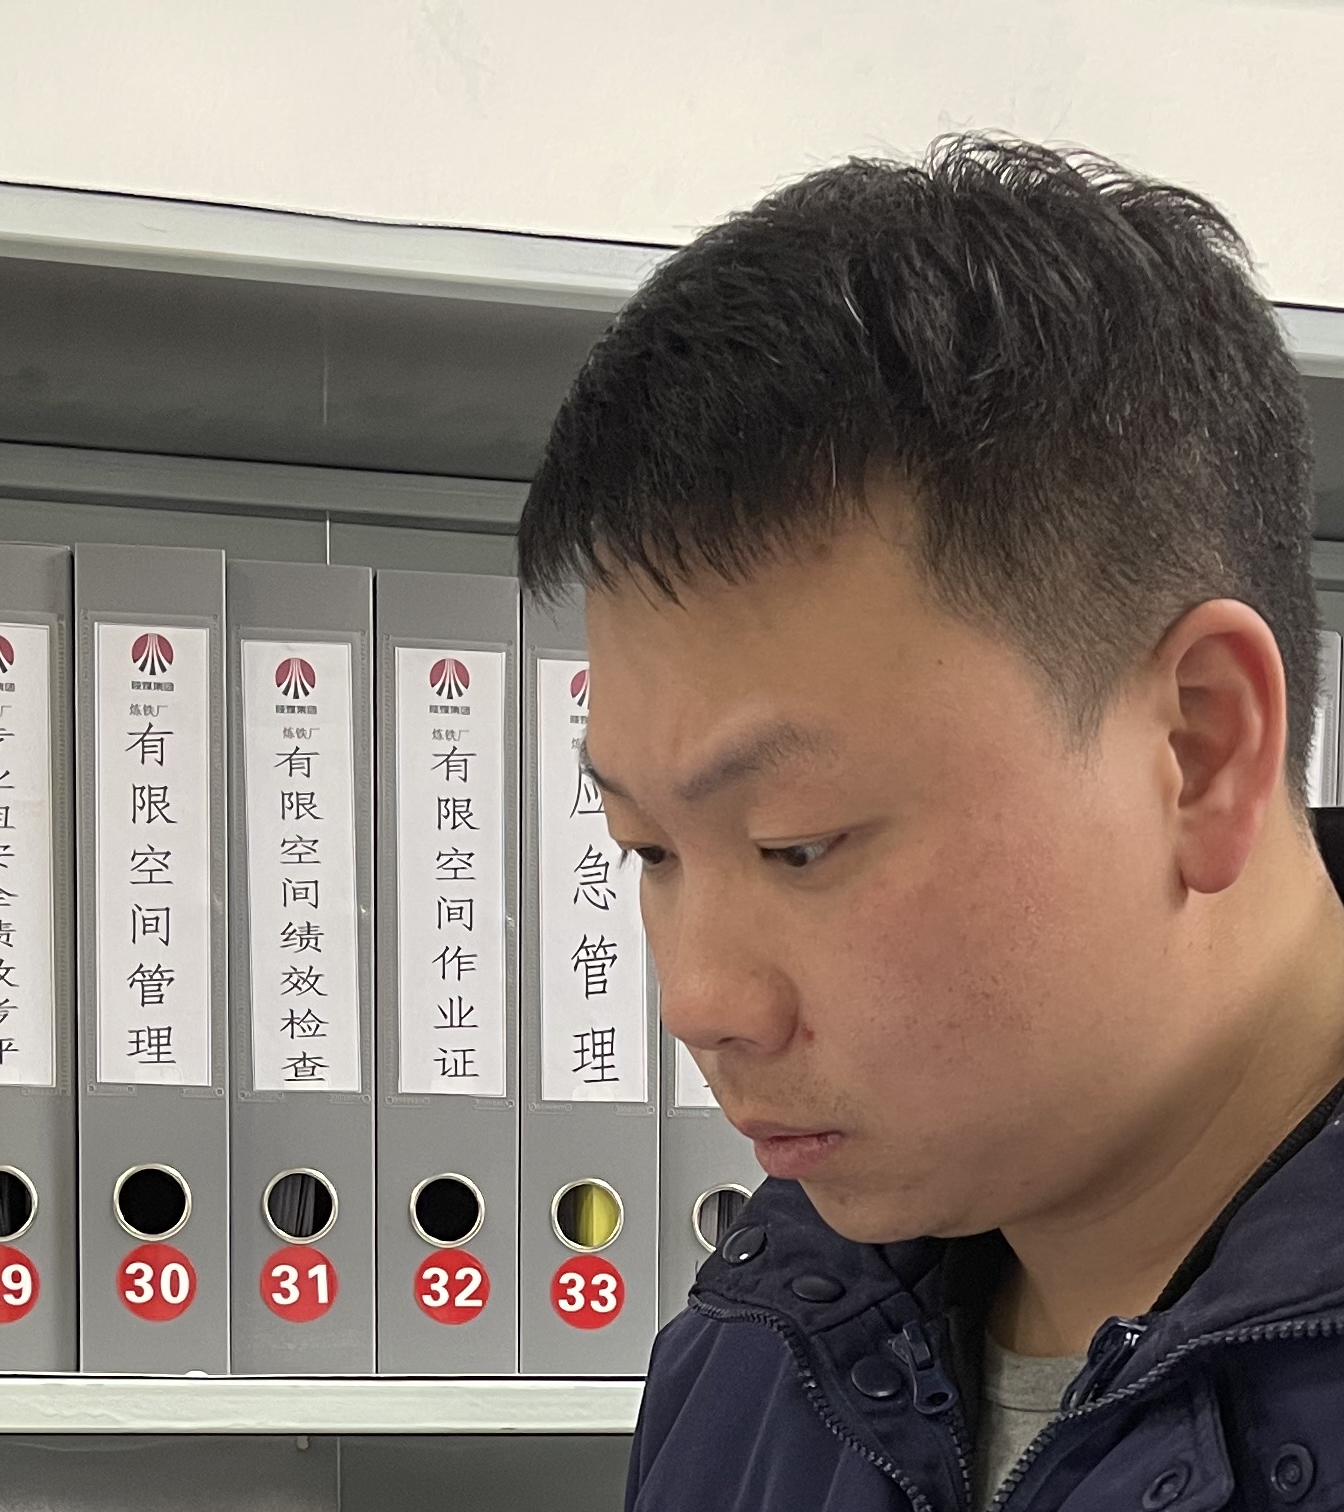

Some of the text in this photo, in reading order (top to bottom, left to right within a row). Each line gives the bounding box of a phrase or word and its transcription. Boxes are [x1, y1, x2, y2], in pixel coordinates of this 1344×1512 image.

[130, 704, 168, 717] 炼铁厂
[283, 727, 319, 739] 炼铁厂
[432, 729, 468, 741] 炼铁厂
[125, 722, 177, 1063] 有限空间管理
[432, 746, 479, 1077] 有限空间作业证
[274, 746, 329, 1081] 有限空间绩效检查
[126, 1263, 189, 1303] 30
[272, 1265, 328, 1304] 31
[422, 1268, 482, 1306] 32
[559, 1273, 616, 1312] 33
